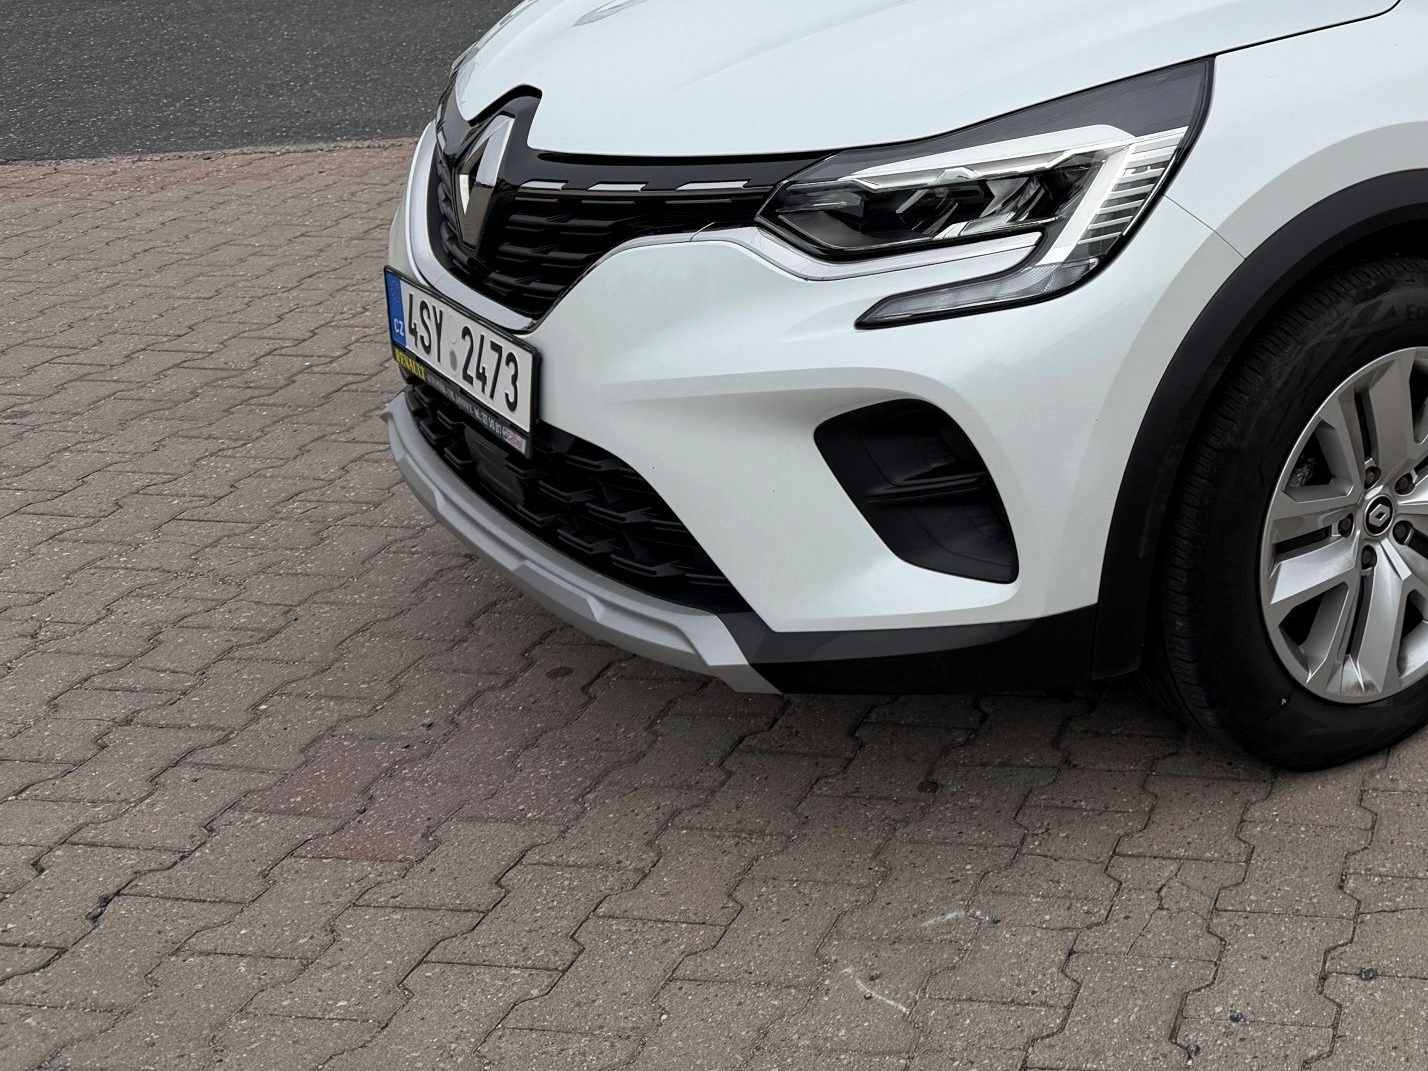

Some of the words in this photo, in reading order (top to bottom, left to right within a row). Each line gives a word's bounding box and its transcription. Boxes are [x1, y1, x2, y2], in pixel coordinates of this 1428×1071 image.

[393, 318, 405, 337] CZ
[408, 293, 444, 365] 4SY
[461, 326, 519, 412] 2473
